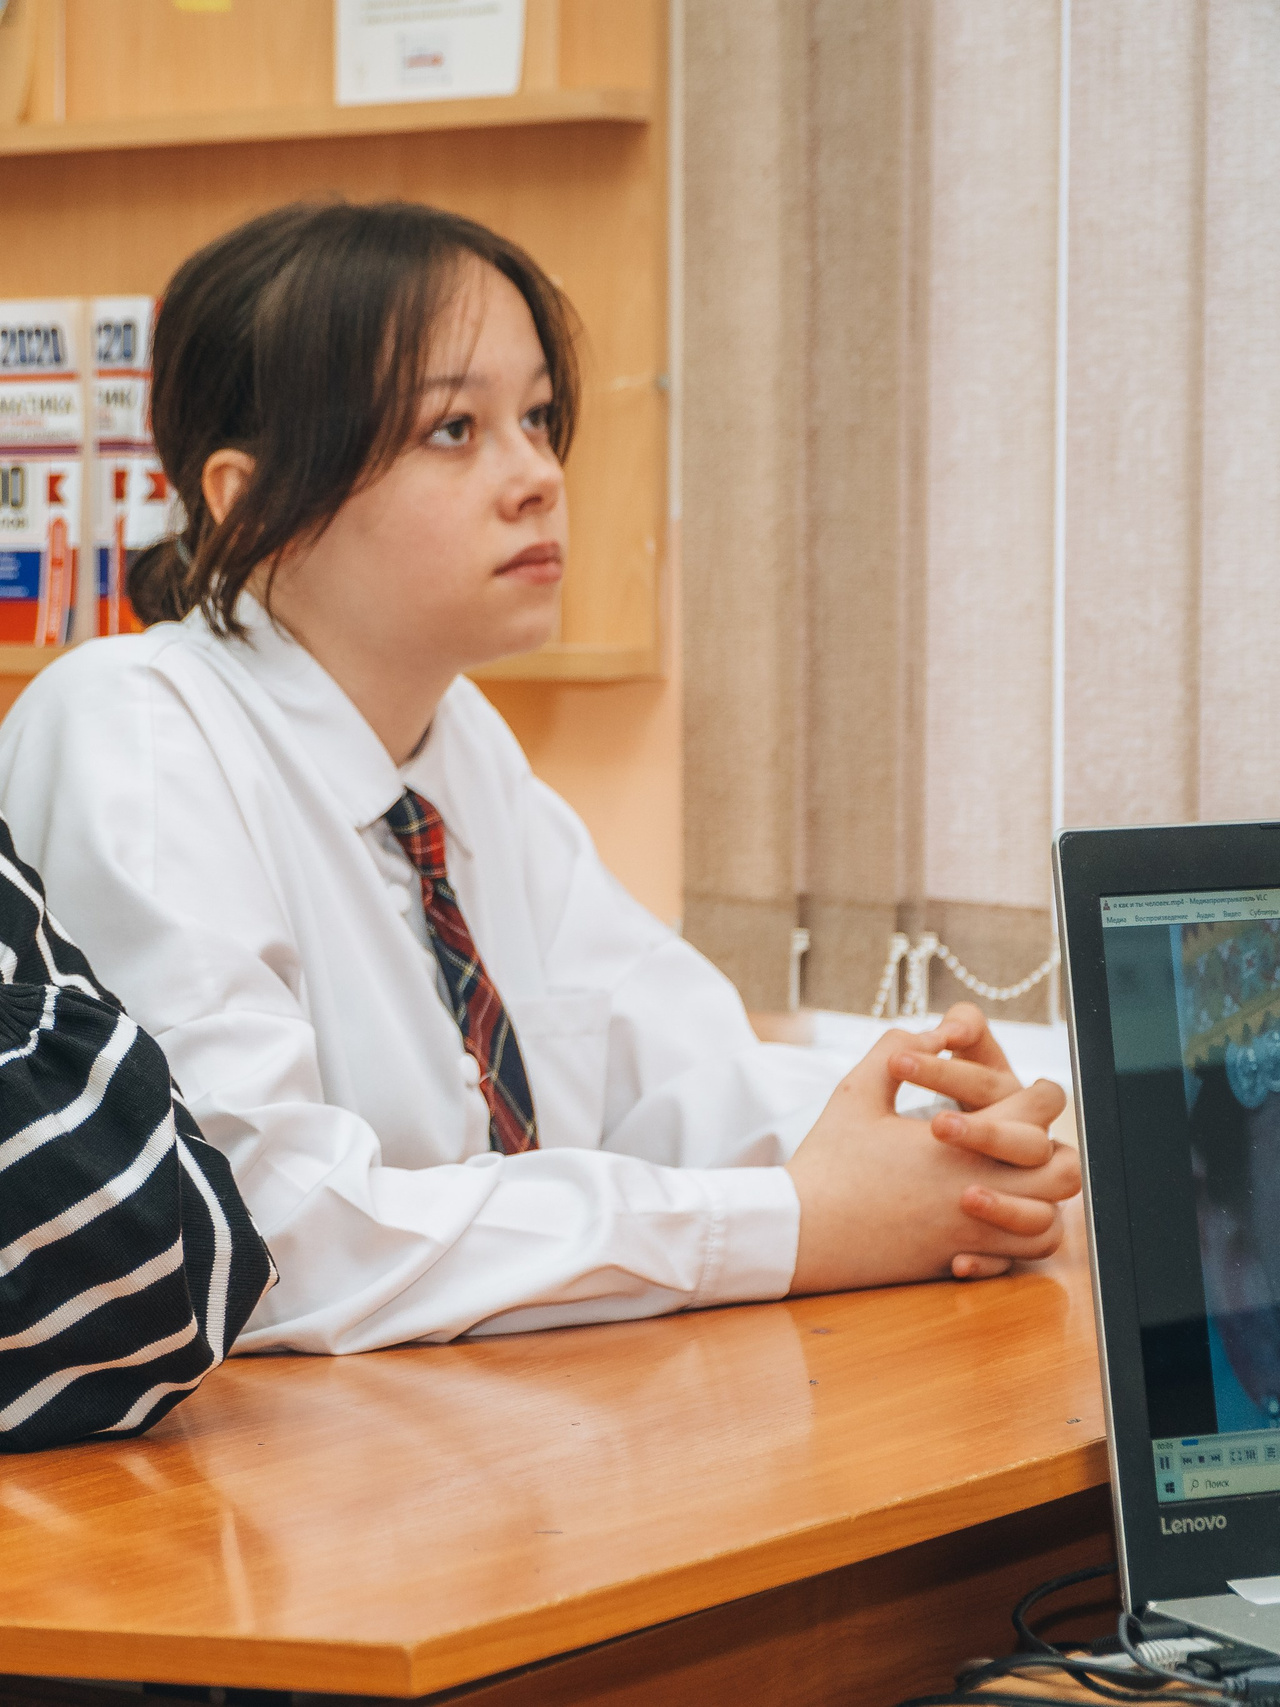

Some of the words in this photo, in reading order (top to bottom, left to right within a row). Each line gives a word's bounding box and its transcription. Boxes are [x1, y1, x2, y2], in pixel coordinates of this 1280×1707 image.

[1256, 893, 1268, 902] VLC
[1205, 1480, 1230, 1489] Поиск
[1160, 1514, 1228, 1535] Lenovo
